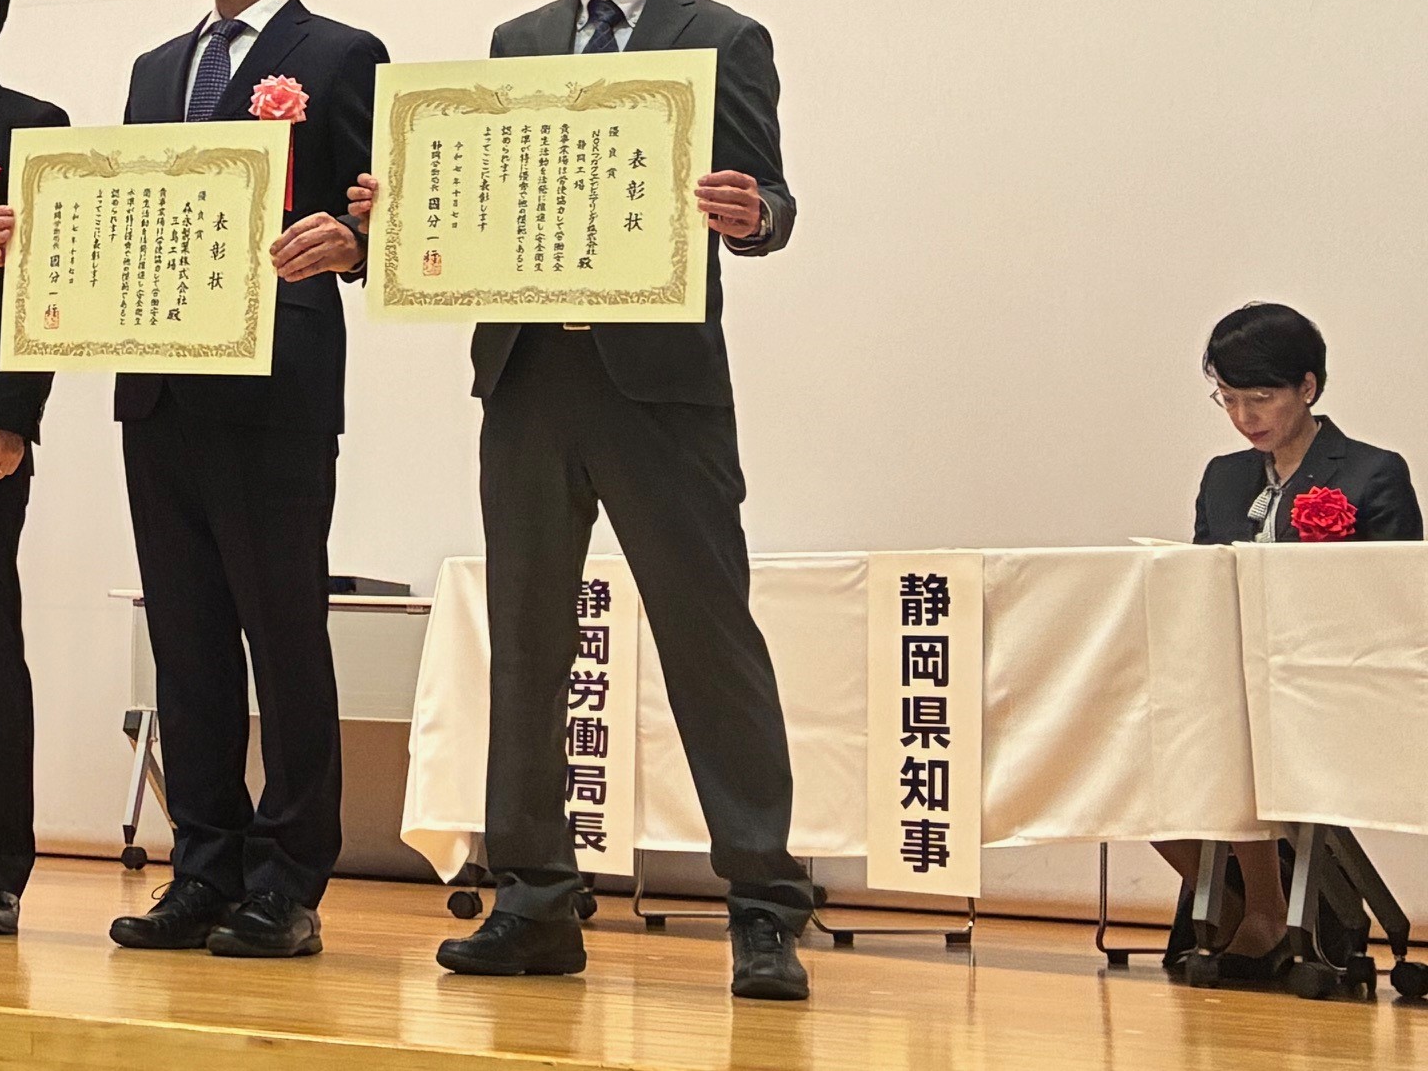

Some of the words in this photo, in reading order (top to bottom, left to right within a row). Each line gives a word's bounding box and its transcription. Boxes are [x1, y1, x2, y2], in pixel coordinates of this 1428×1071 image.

[206, 211, 229, 291] 表彰状
[622, 148, 647, 232] 表彰状
[565, 577, 612, 855] 静岡労働局長
[899, 572, 952, 874] 静岡県知事
